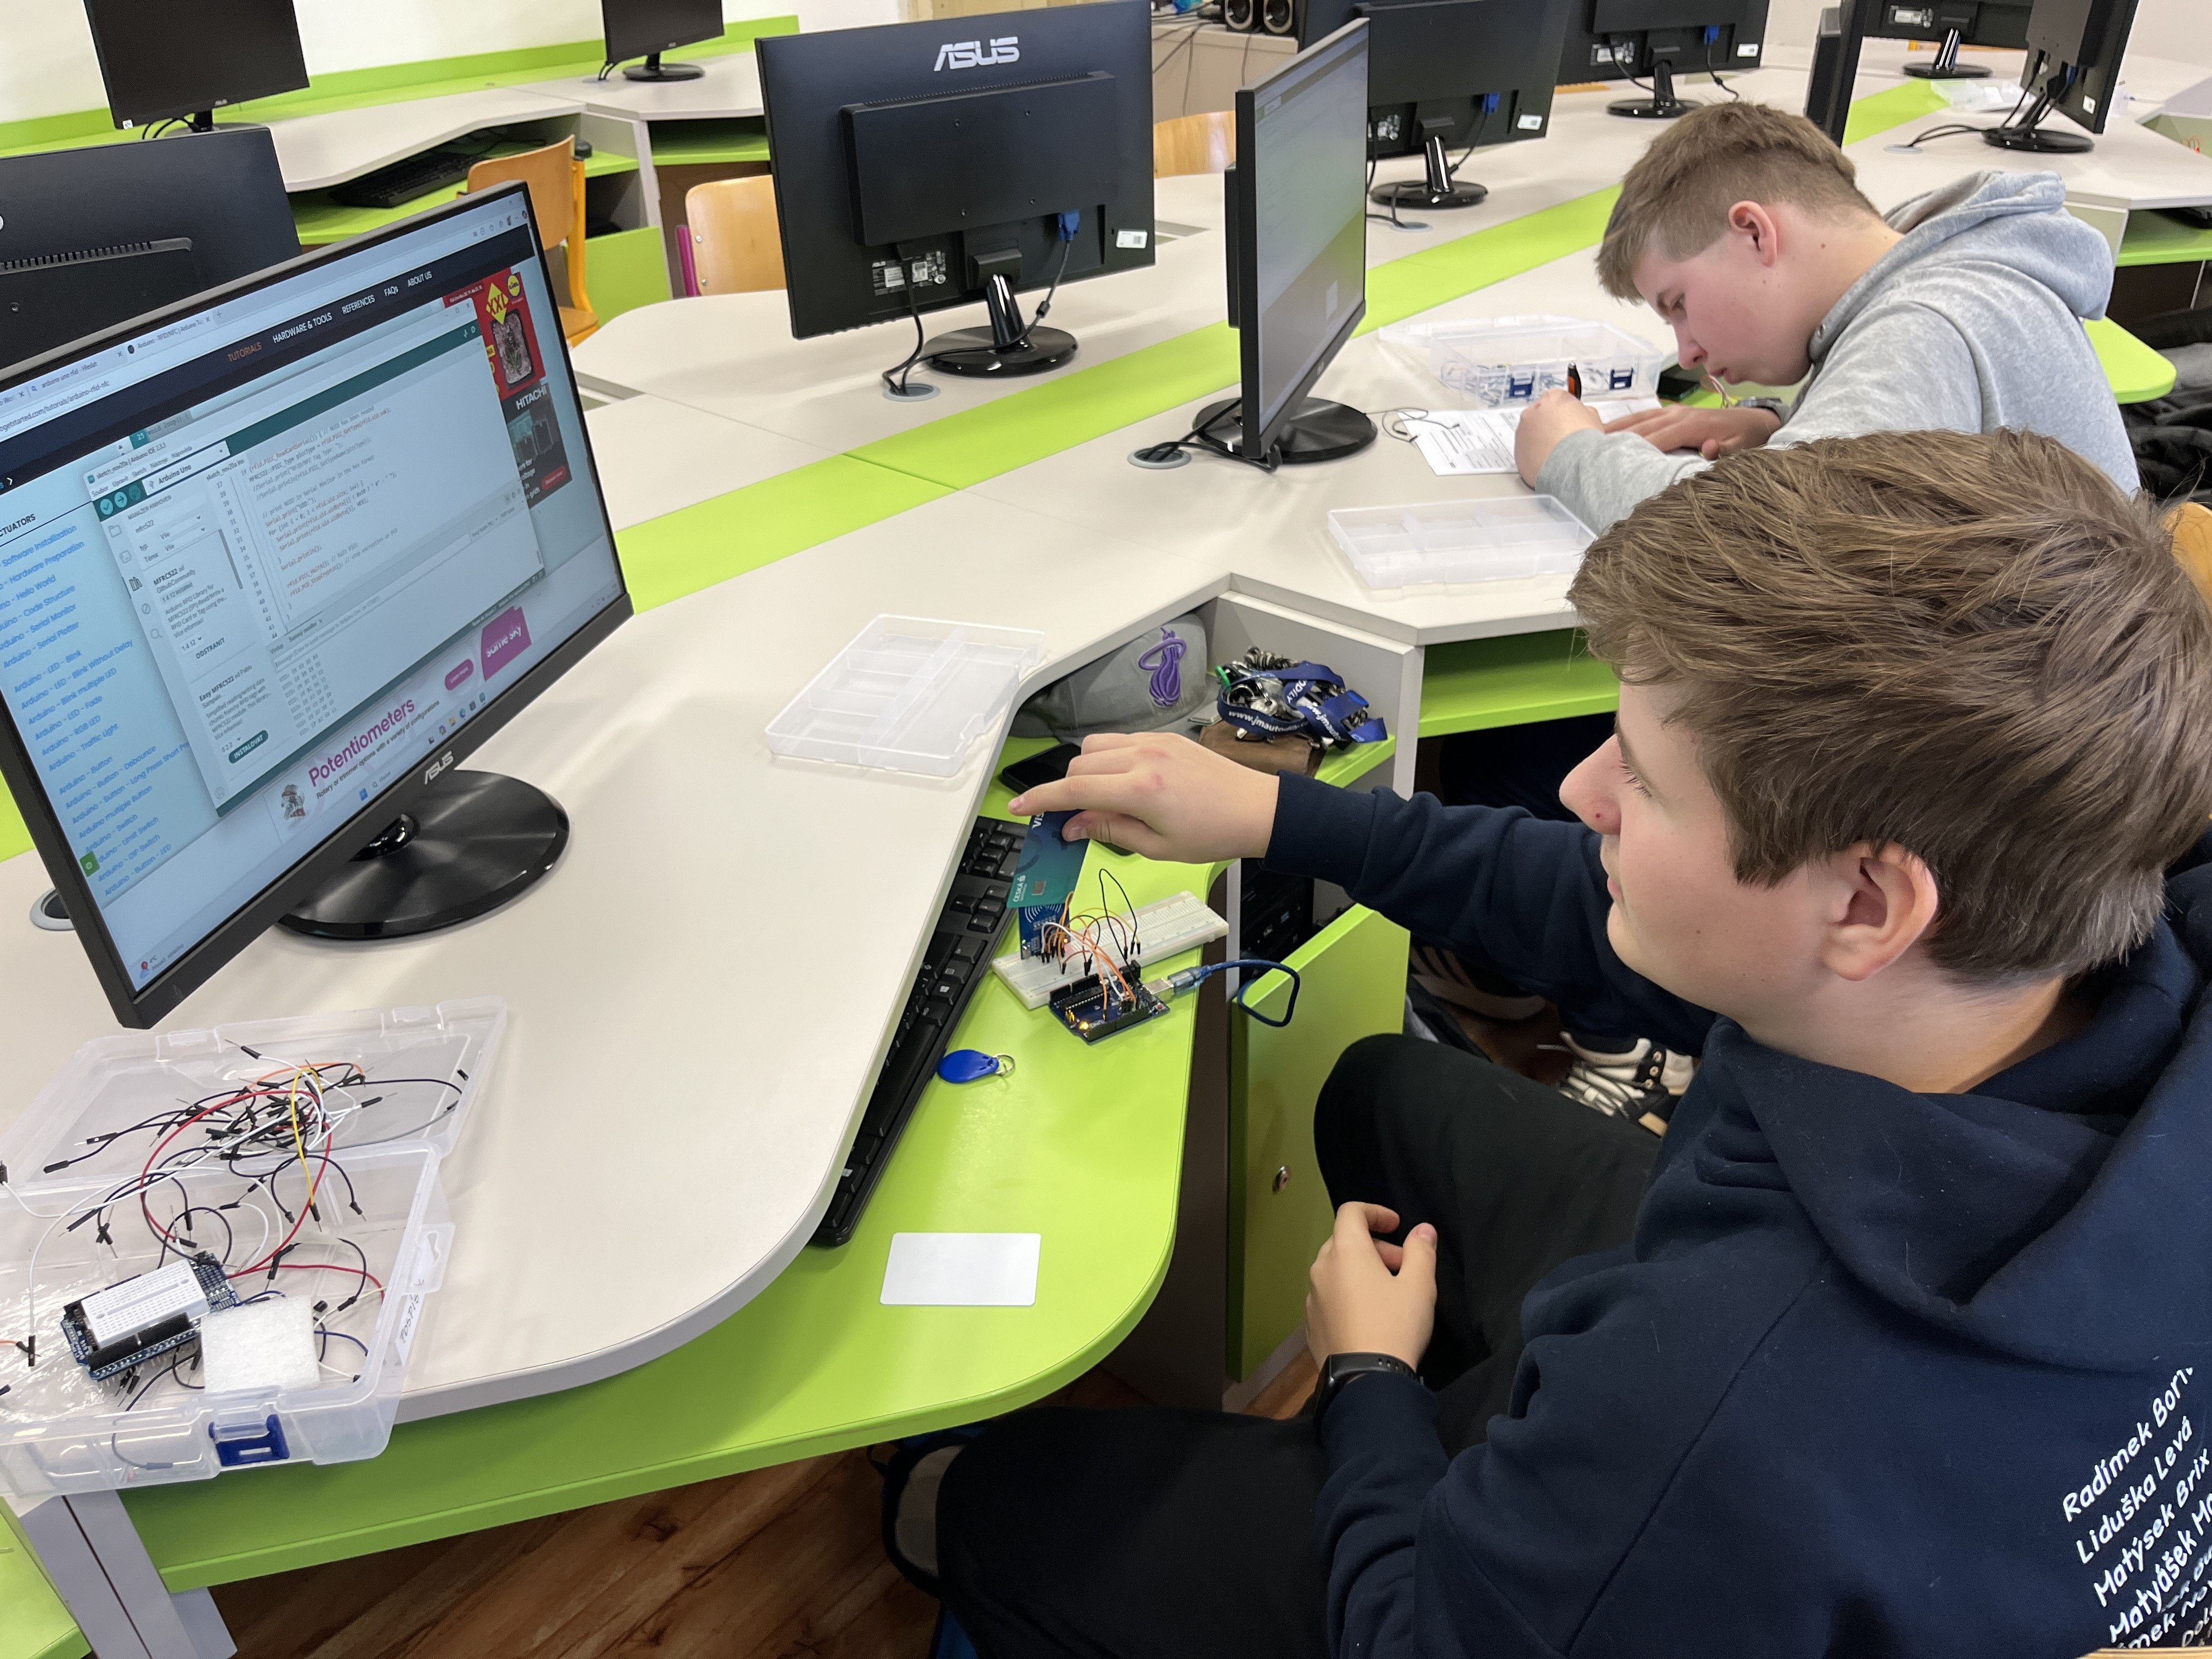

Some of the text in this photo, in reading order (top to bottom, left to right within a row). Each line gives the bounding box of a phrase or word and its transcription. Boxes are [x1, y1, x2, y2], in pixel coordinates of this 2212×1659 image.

[933, 36, 1020, 71] ASUS
[383, 284, 399, 298] FAQs
[407, 270, 432, 287] ABOUT US
[341, 294, 376, 315] REFERENCES
[487, 293, 507, 316] XXL
[137, 337, 155, 349] Arduino
[272, 312, 333, 344] HARDWARE & TOOLS
[227, 341, 263, 363] TUTORIALS
[515, 385, 548, 410] HITACHI
[136, 432, 145, 441] 25
[129, 450, 149, 463] Arduino
[131, 466, 147, 478] Sketch
[111, 475, 129, 488] Upravit
[157, 463, 192, 484] Arduino Uno
[91, 484, 109, 498] Soubor
[134, 519, 155, 534] mfrc522
[160, 530, 171, 540] Vše
[1, 545, 35, 567] Software
[8, 539, 86, 584] Hardware Preparation
[164, 541, 175, 552] Vše
[15, 574, 57, 601] Hello World
[153, 568, 178, 586] MFRC522
[22, 584, 76, 617] Code Structure
[30, 617, 51, 634] Serial
[49, 602, 77, 622] Monitor
[2, 619, 81, 669] Arduino Serial Plotter
[195, 636, 226, 660] ODSTRANIT
[485, 621, 523, 659] same sky
[13, 648, 82, 694] Arduino LED Blink
[20, 638, 134, 710] Arduino LED Blink Without Delay
[27, 667, 117, 726] Arduino Blink multiple LED
[199, 689, 212, 703] Easy
[211, 675, 234, 694] MFRC522
[34, 693, 103, 741] Arduino LED Fade
[41, 714, 101, 757] Arduino RGB LED
[48, 721, 120, 772] Arduino Traffic Light
[233, 734, 264, 759] INSTALOVAT
[308, 693, 416, 788] Potentiometers
[316, 782, 334, 801] Rotary
[332, 777, 340, 787] or
[338, 762, 358, 782] trimmer
[358, 748, 376, 768] options
[375, 740, 386, 753] with
[390, 725, 406, 743] variety
[404, 721, 410, 730] of
[410, 698, 440, 727] configurations
[58, 755, 114, 795] Arduino Button
[64, 744, 157, 810] Arduino Button Debounce
[425, 751, 454, 785] ASUS
[71, 802, 99, 825] Arduino
[103, 783, 126, 803] Button
[129, 769, 147, 787] Long
[145, 758, 163, 774] Press
[162, 747, 179, 763] Short
[78, 783, 153, 839] Arduino multiple Button
[84, 812, 138, 854] Arduino Switch
[121, 830, 138, 846] Limit
[137, 815, 159, 834] Switch
[97, 832, 161, 882] Arduino DIP Switch
[104, 842, 172, 897] Arduino Button LED
[2076, 1474, 2156, 1564] Liduška
[2154, 1415, 2192, 1480] Levá
[2094, 1503, 2175, 1607] Matýsek
[2176, 1448, 2210, 1508] Brix
[2109, 1530, 2197, 1643] Matyášek
